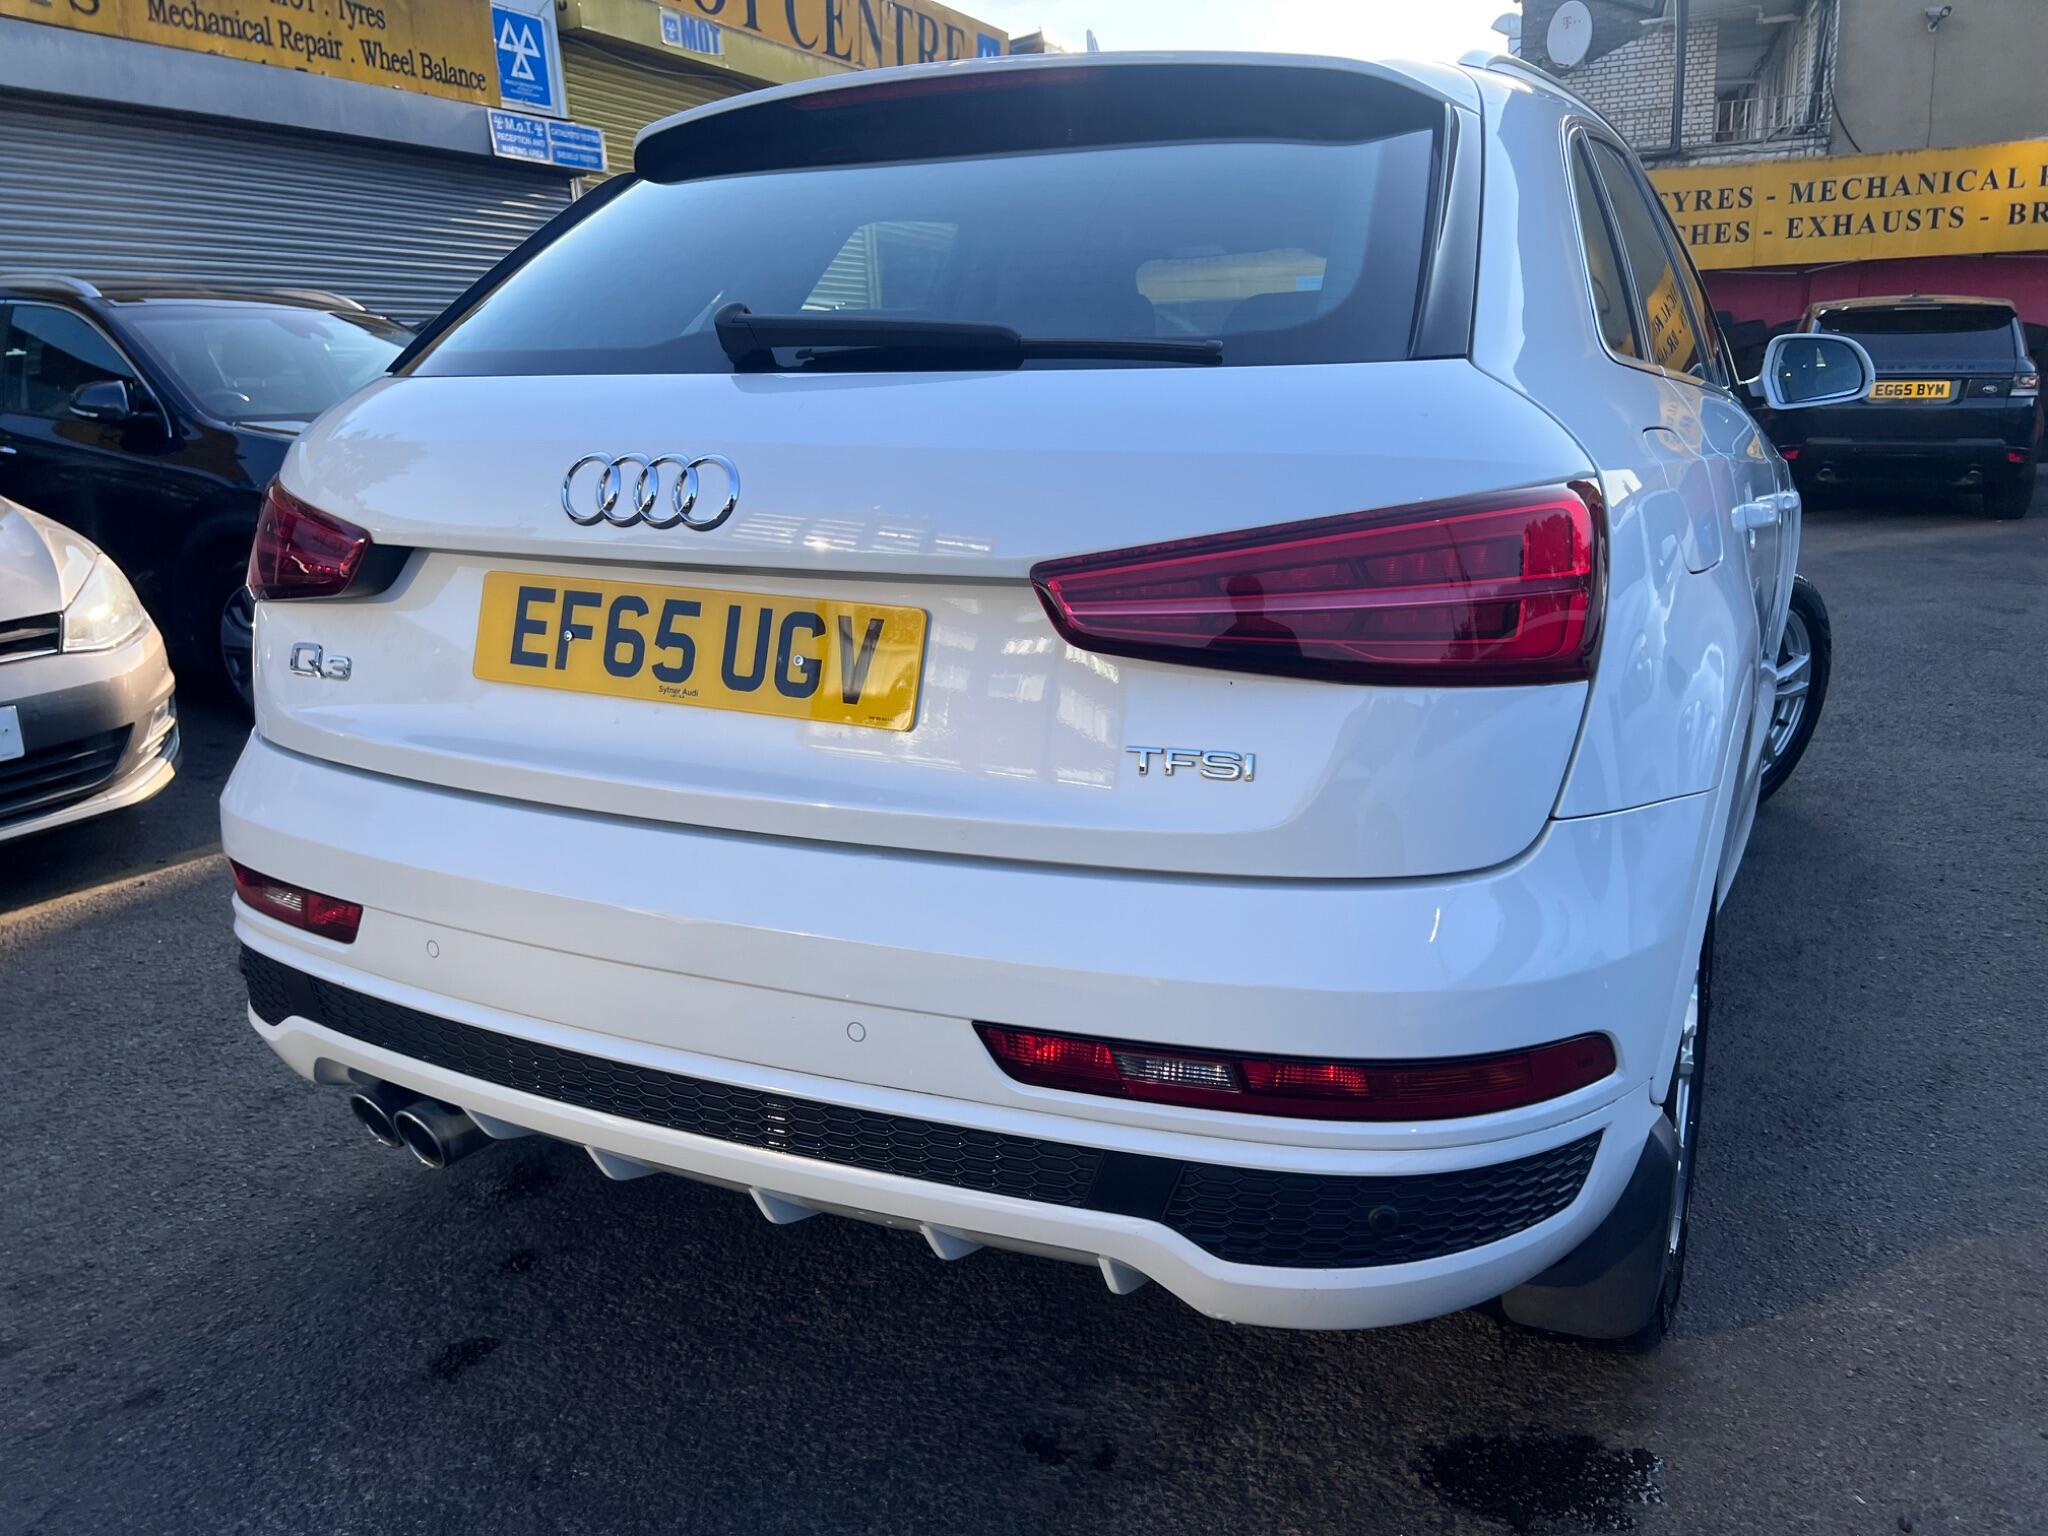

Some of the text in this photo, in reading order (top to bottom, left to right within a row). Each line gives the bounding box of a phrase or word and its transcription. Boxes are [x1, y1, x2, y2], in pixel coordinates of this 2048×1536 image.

[148, 0, 274, 46] Mechanical
[278, 19, 343, 62] Repair
[360, 39, 417, 77] Wheel
[420, 52, 487, 91] Balance
[681, 15, 721, 54] MOT
[784, 0, 965, 67] CENTRE
[1788, 167, 2025, 205] MECHANICAL
[1677, 220, 1750, 246] HES
[1786, 206, 1965, 240] EXHAUSTS
[1875, 384, 1912, 396] EG65
[290, 642, 352, 681] Q3
[510, 586, 885, 705] EF65 UGV
[682, 688, 699, 697] Audi
[1126, 746, 1256, 782] TFSI
